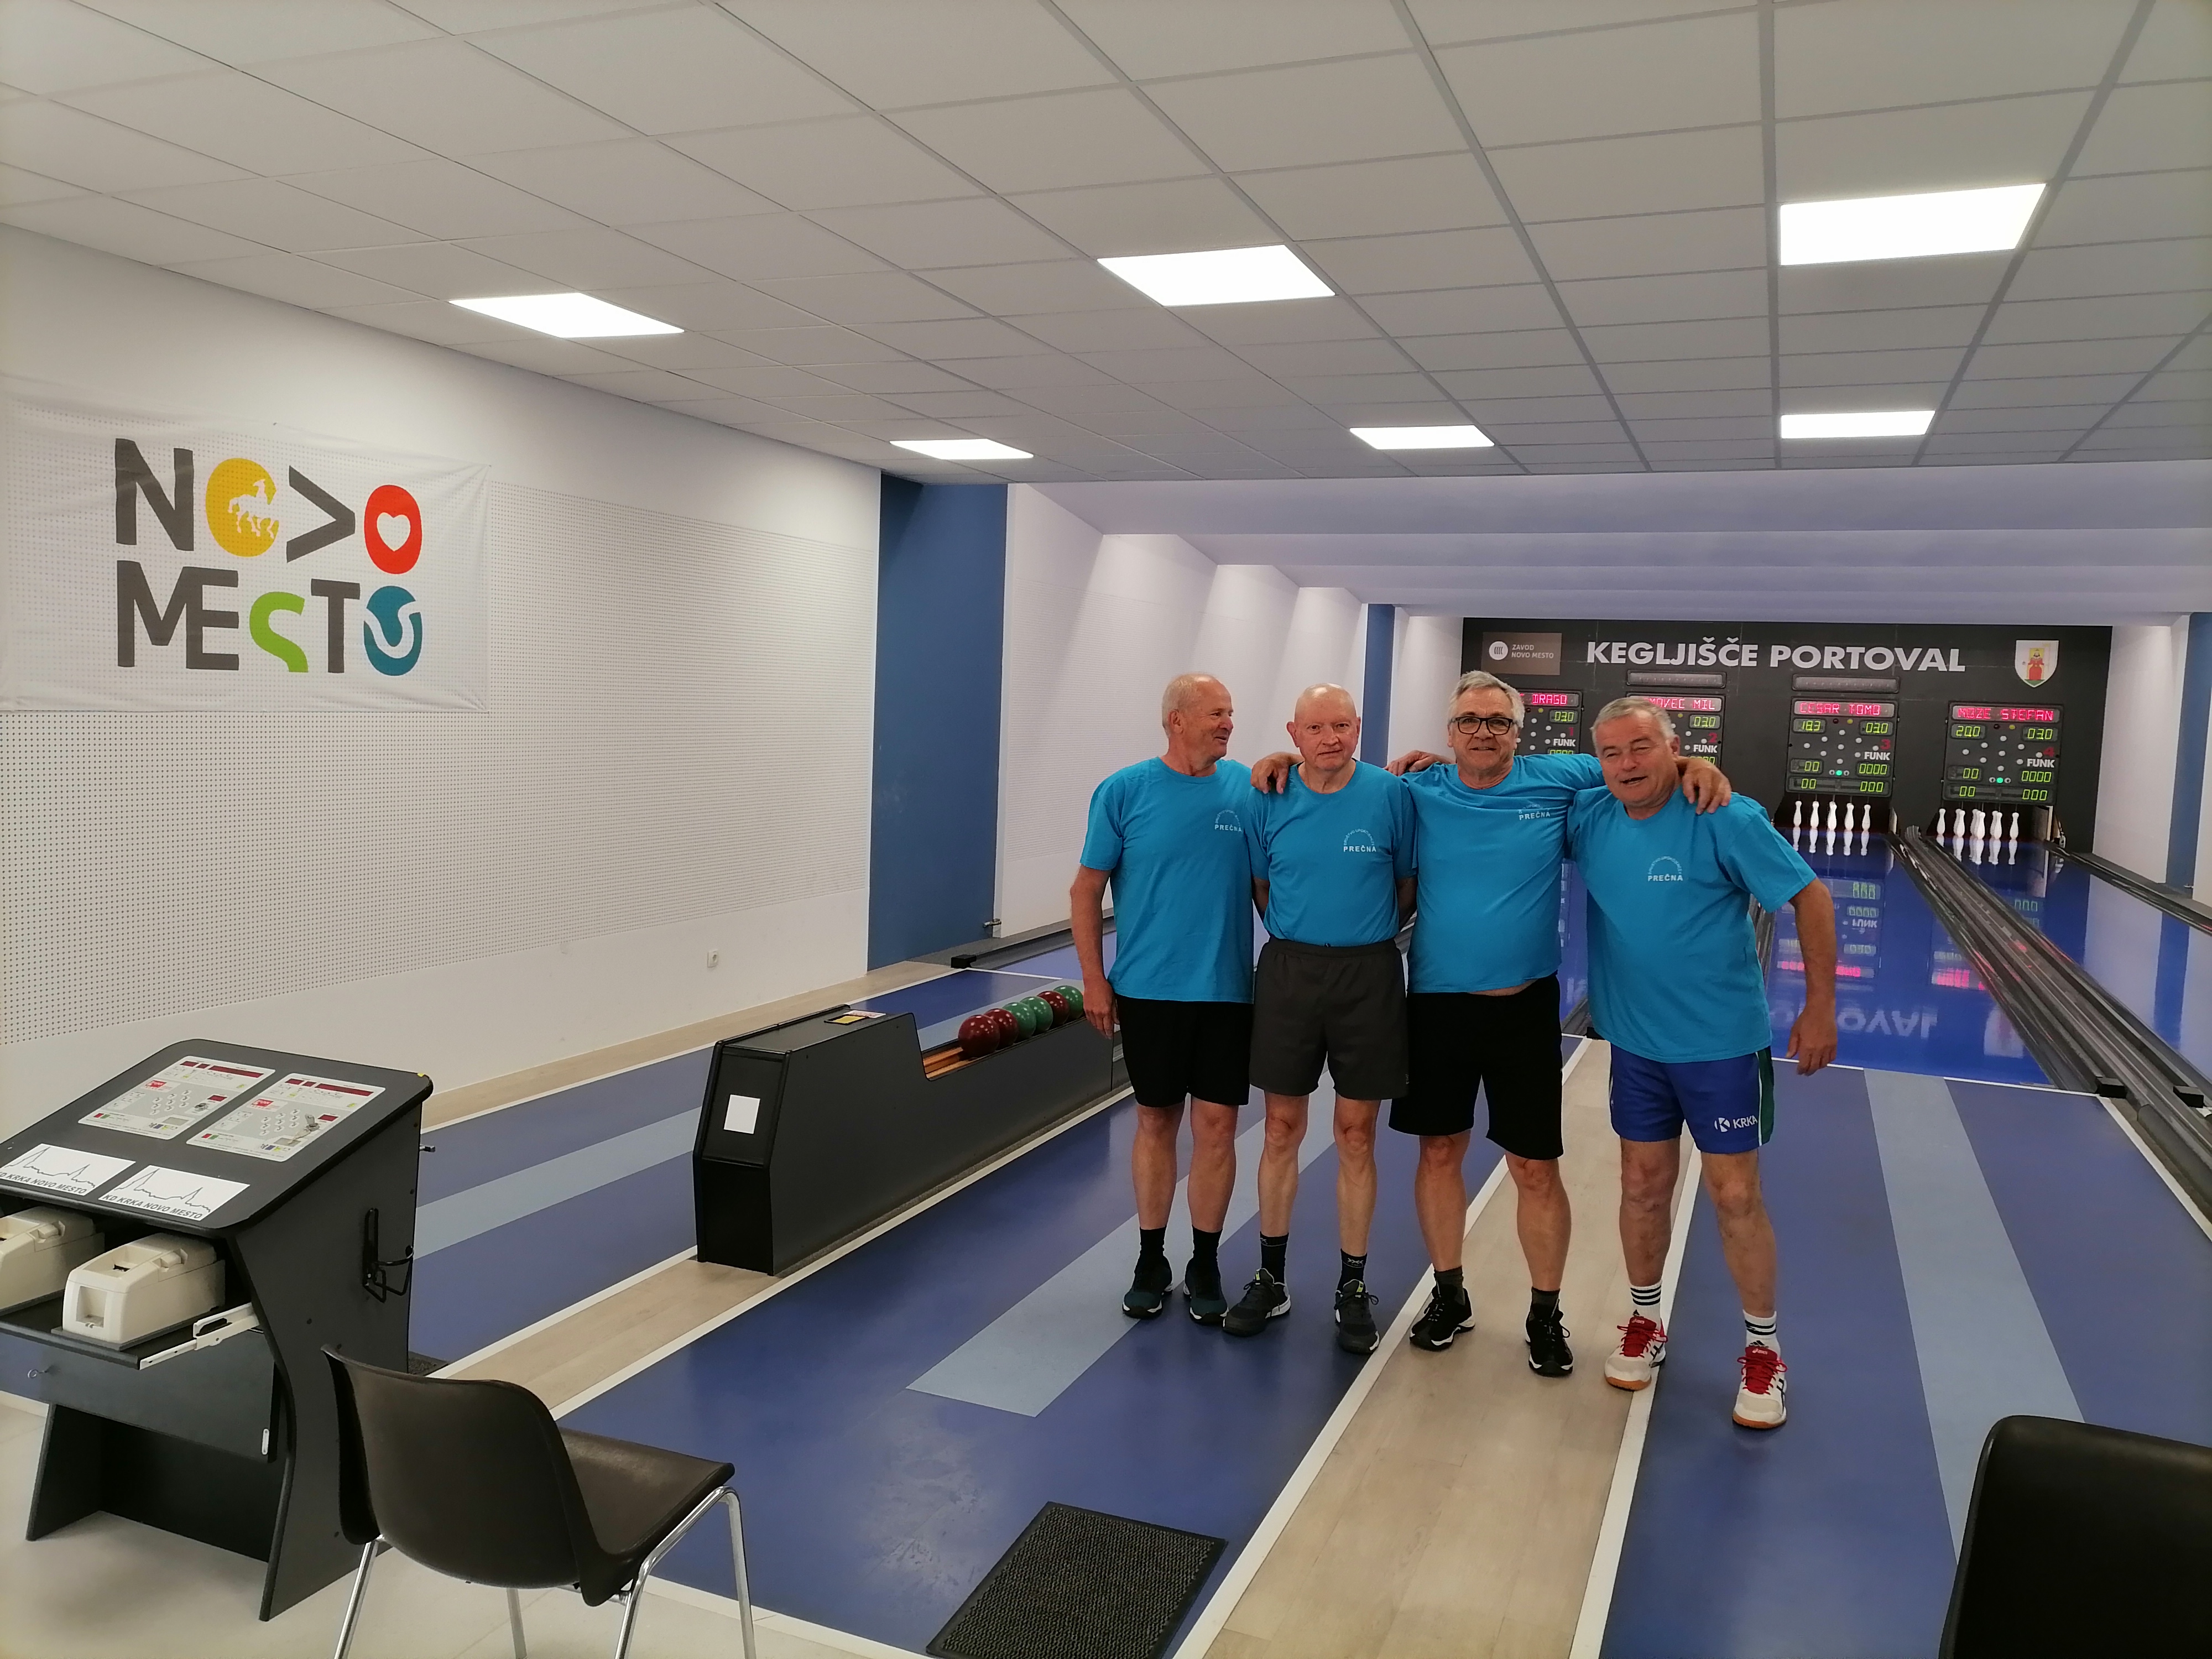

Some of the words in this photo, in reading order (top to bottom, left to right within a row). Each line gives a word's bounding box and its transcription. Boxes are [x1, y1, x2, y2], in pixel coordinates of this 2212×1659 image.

[117, 560, 422, 676] MESTO
[1587, 637, 1758, 667] KEGLJIŠČE
[1770, 645, 1965, 672] PORTOVAL
[1532, 694, 1567, 705] DRAGO
[1645, 698, 1686, 709] MOVEC
[1693, 700, 1715, 710] MIL
[1800, 703, 1840, 713] CESAR
[1849, 704, 1881, 715] TOMO
[1958, 708, 1991, 719] MOZE
[2001, 709, 2054, 721] STEFAN
[1569, 727, 1574, 736] 1
[1708, 733, 1718, 743] 2
[1693, 744, 1718, 753] FUNK
[1881, 739, 1891, 749] 3
[1864, 752, 1890, 760] FUNK
[2043, 747, 2054, 757] 4
[1804, 761, 1820, 771] 00
[1859, 763, 1887, 775] 0000
[2027, 759, 2056, 768] FUNK
[1963, 768, 1979, 779] 00
[2021, 771, 2052, 782] 0000
[1801, 779, 1817, 789] 00
[1860, 781, 1884, 792] 000
[1959, 786, 1976, 797] 00
[2022, 789, 2047, 801] 000
[1519, 811, 1550, 821] PREČNA
[1214, 824, 1242, 832] PREČNA
[1647, 873, 1683, 881] PREČNA
[1733, 1115, 1758, 1129] KRKA
[7, 1173, 32, 1183] KRKA
[30, 1179, 56, 1187] NOVO
[55, 1184, 87, 1194] MESTO
[117, 1197, 144, 1206] KRKA
[143, 1203, 171, 1212] NOVO
[169, 1208, 203, 1219] MESTO
